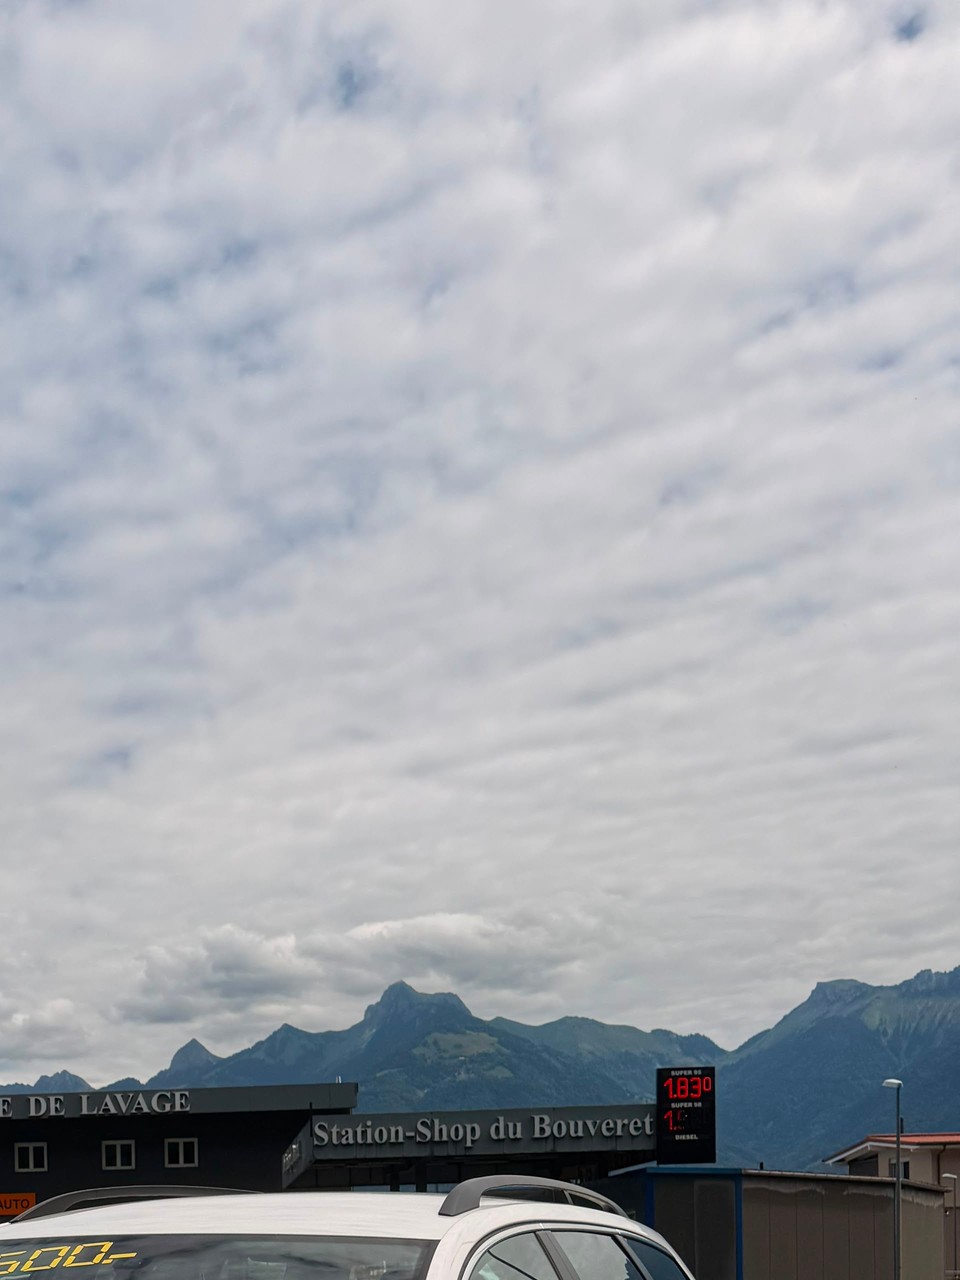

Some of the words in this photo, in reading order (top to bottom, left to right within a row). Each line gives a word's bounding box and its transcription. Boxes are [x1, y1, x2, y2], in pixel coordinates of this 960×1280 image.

[29, 1095, 65, 1117] DE
[80, 1091, 190, 1115] LAVAGE
[313, 1117, 481, 1147] Station-Shop
[490, 1114, 523, 1140] du
[532, 1113, 654, 1139] Bouveret
